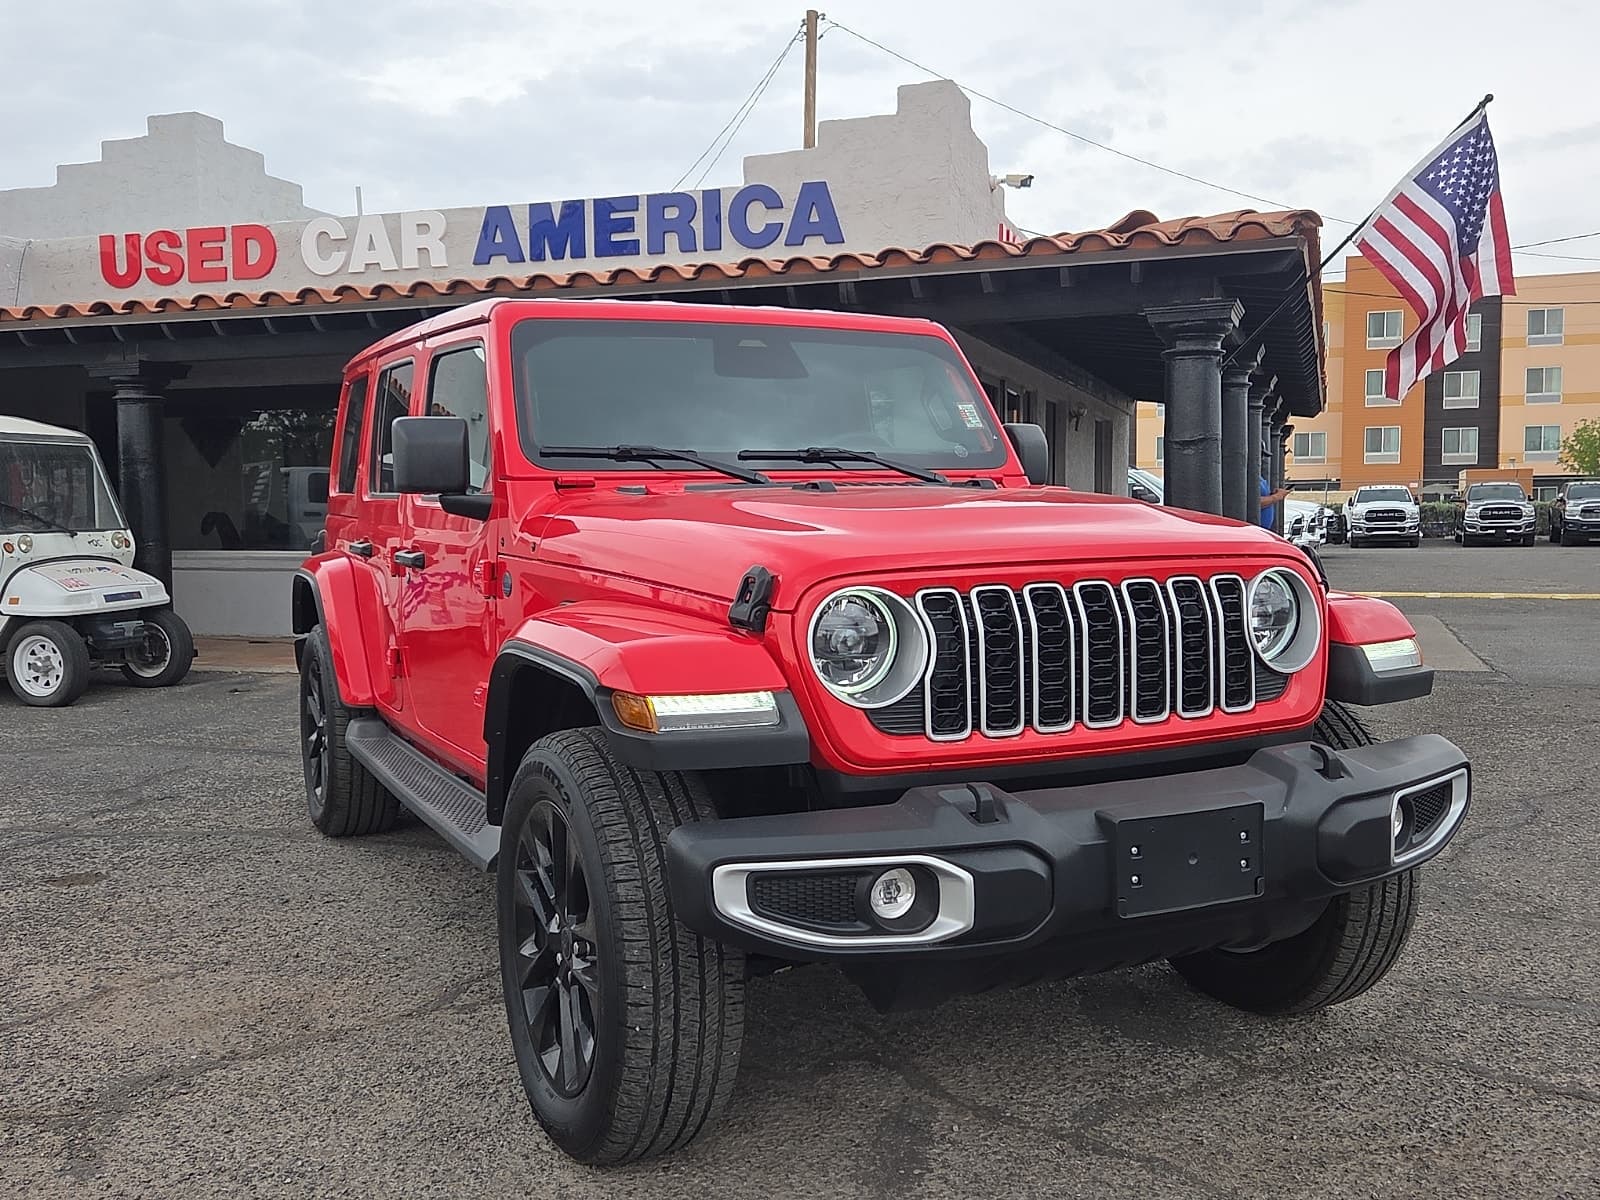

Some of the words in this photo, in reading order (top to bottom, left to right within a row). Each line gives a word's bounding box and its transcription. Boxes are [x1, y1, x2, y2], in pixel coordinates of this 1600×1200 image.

[99, 223, 277, 289] USED
[300, 210, 448, 276] CAR
[472, 181, 845, 265] AMERICA
